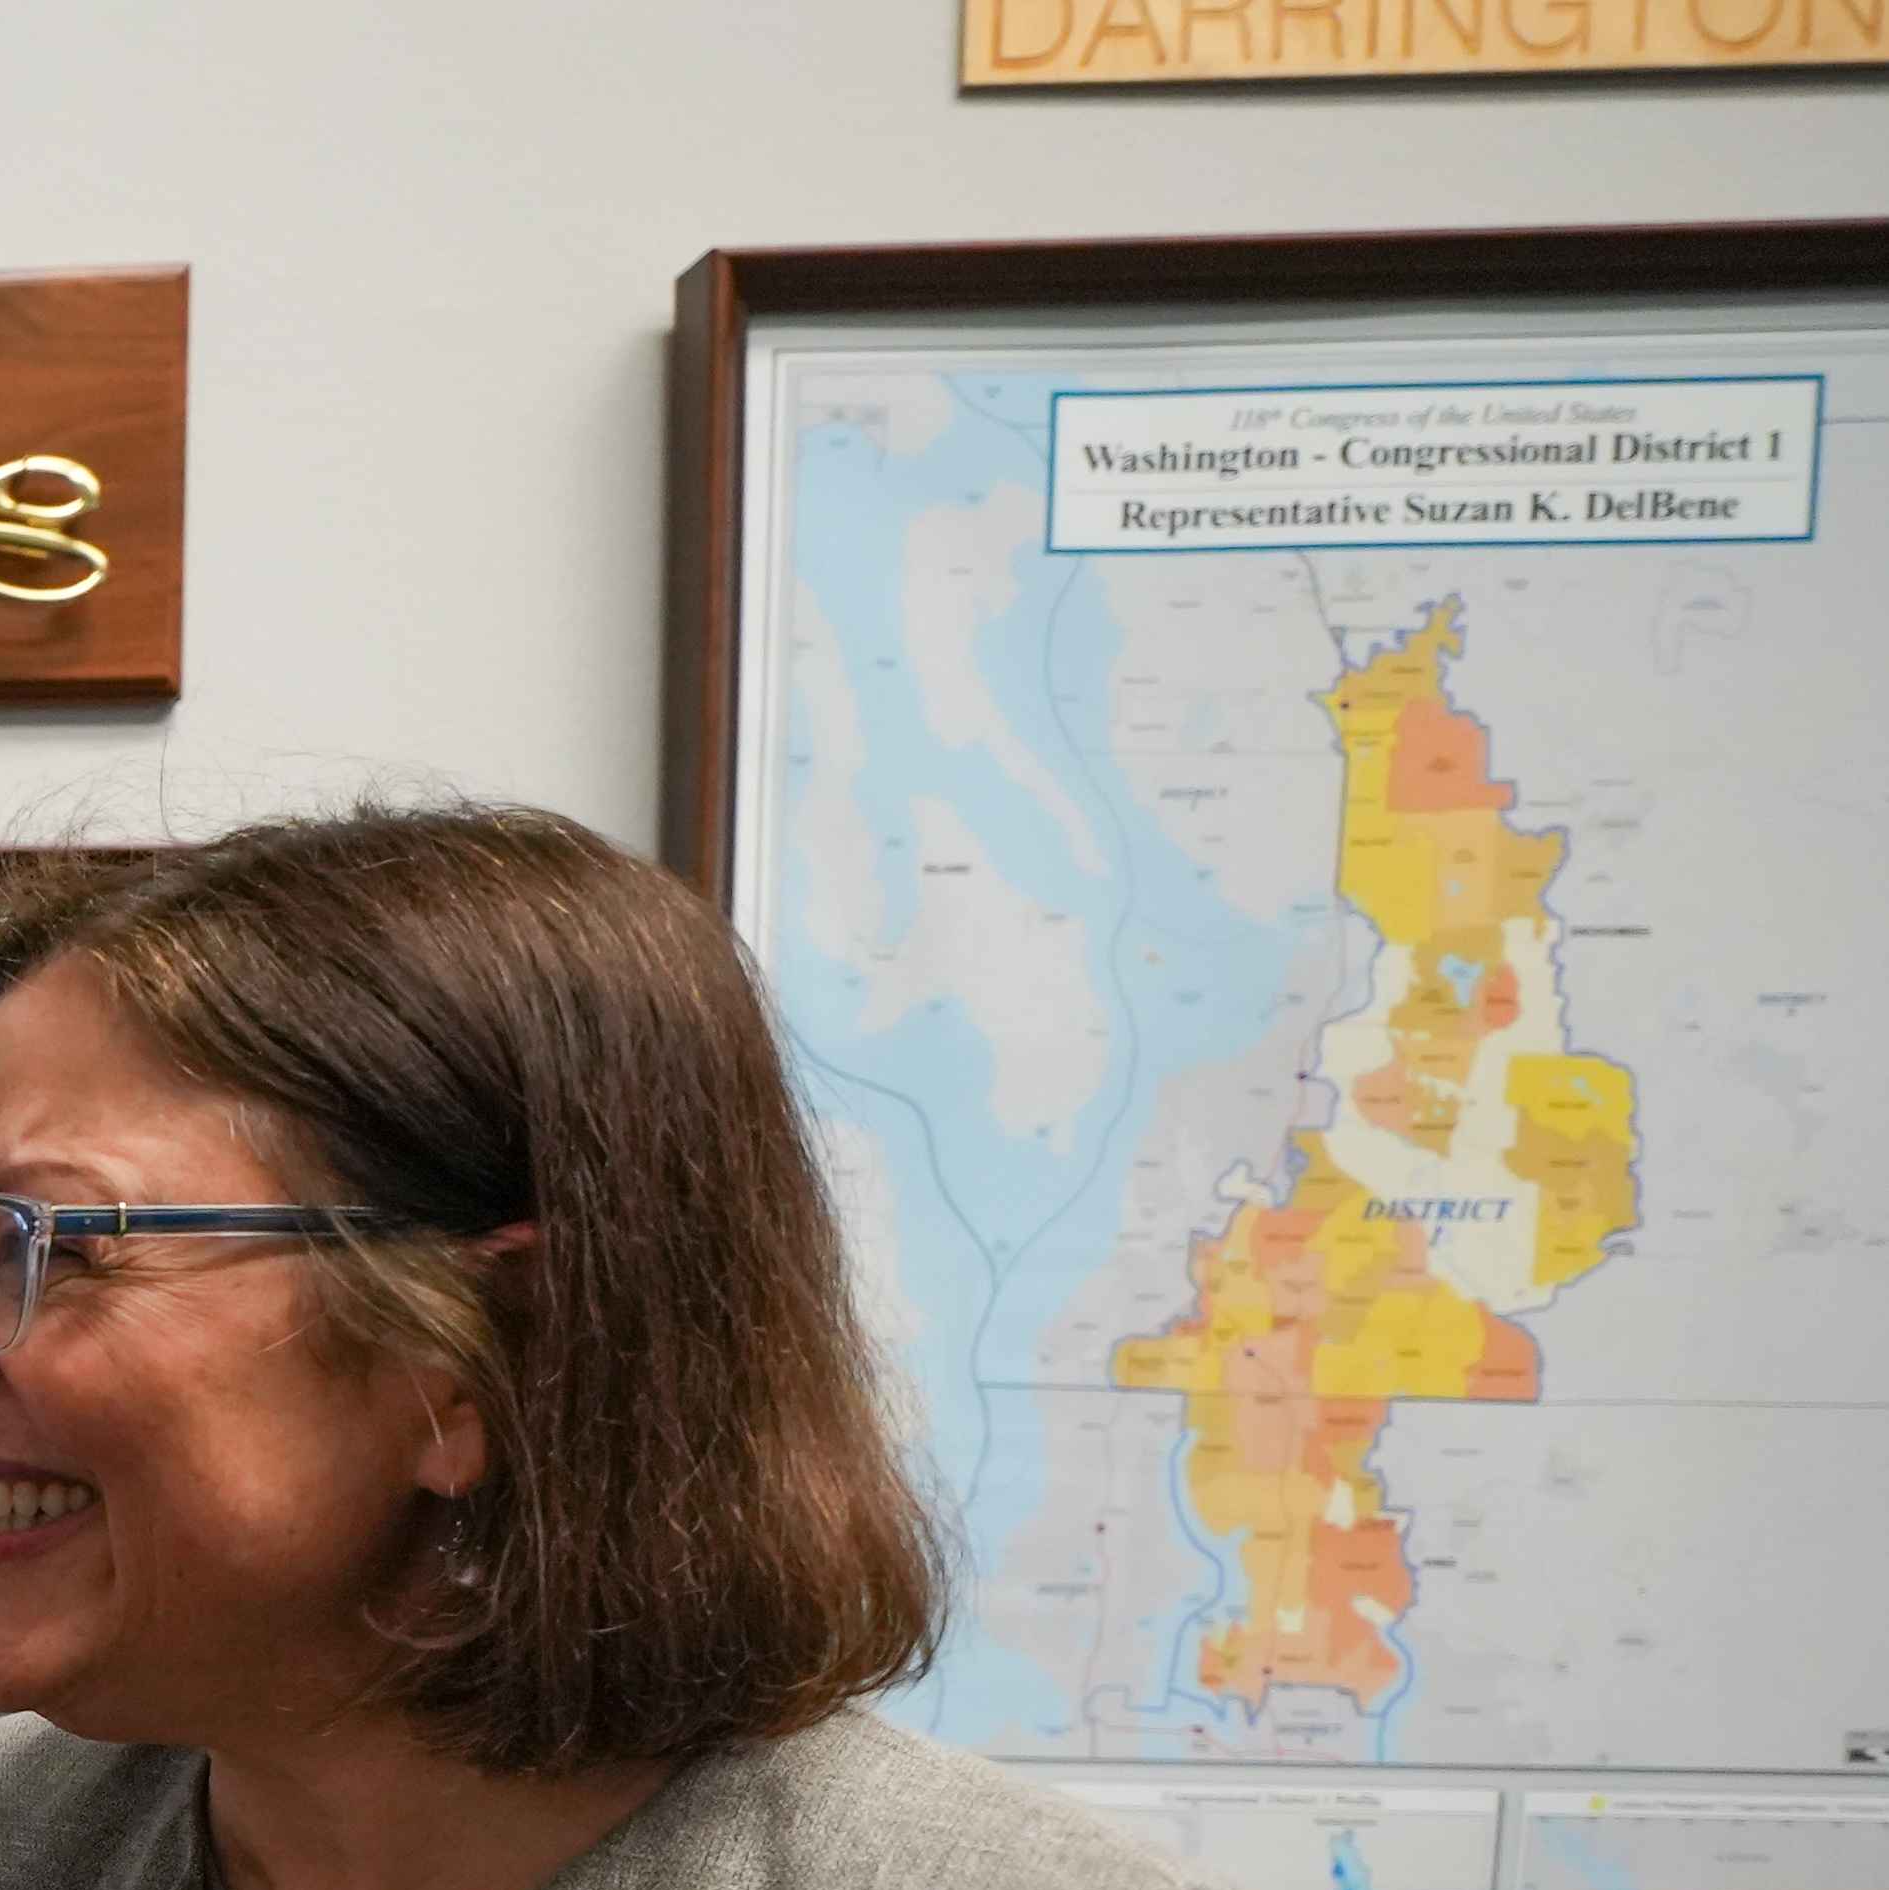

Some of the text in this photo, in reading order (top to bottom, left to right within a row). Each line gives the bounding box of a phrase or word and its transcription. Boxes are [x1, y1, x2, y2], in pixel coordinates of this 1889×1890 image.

[1289, 406, 1399, 432] Congress
[1482, 402, 1560, 424] United
[1564, 401, 1637, 424] States
[1083, 442, 1299, 479] Washington
[1339, 434, 1597, 475] Congressional
[1612, 430, 1751, 465] District
[1767, 429, 1781, 459] 1
[1120, 489, 1740, 536] Representative Suzan K. DelBene
[1363, 1198, 1513, 1223] DISTRICT
